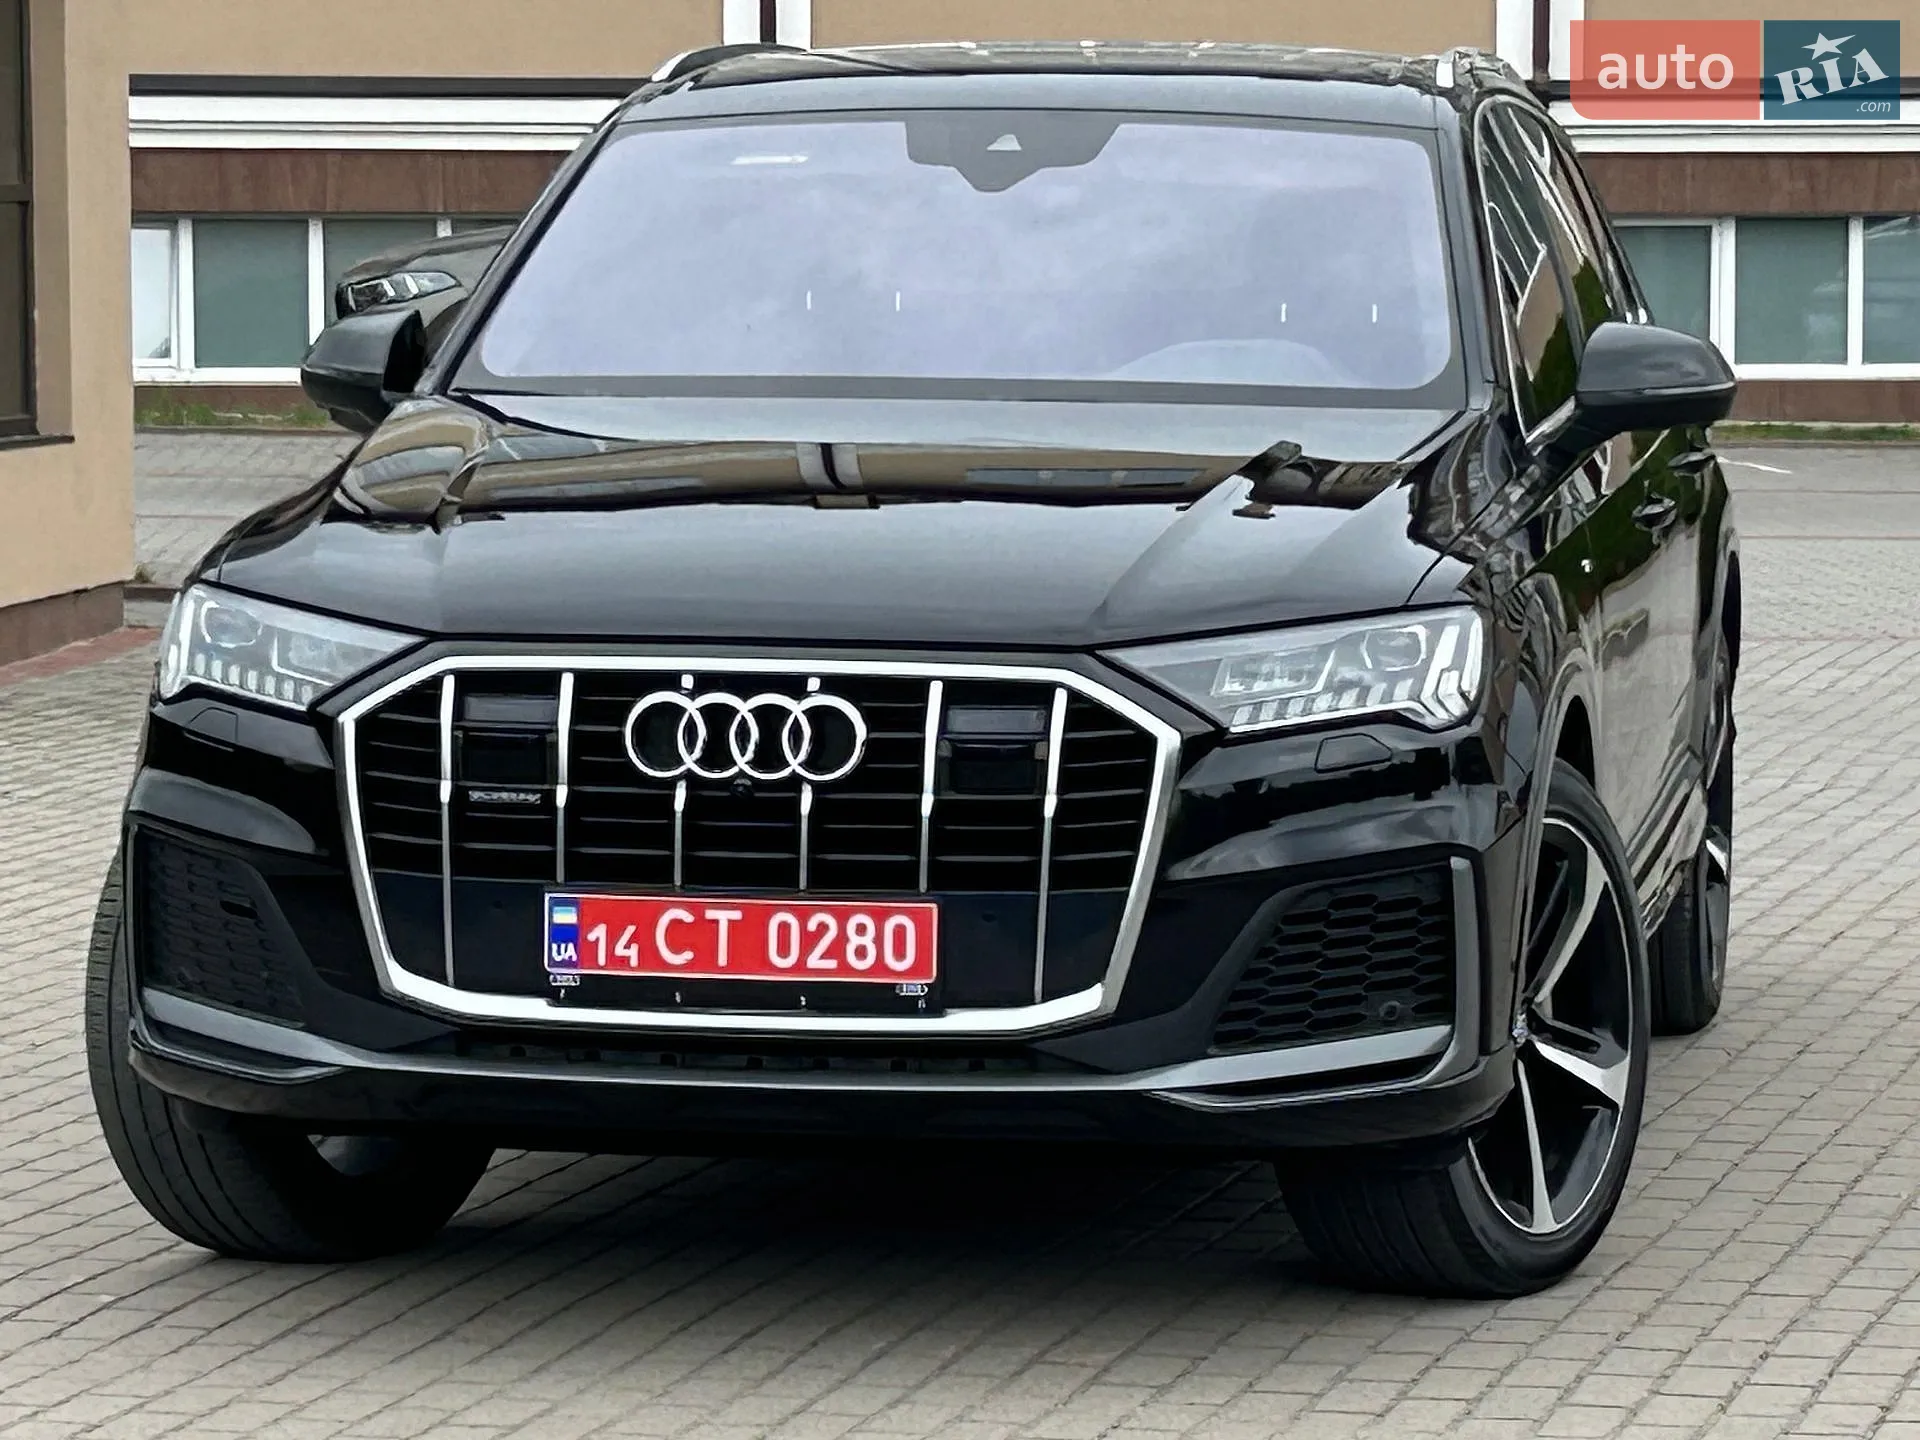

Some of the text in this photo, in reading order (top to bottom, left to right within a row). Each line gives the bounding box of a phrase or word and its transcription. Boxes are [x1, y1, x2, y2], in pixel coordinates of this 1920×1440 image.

[551, 942, 578, 962] UA
[586, 908, 916, 972] 14 CT 0280
